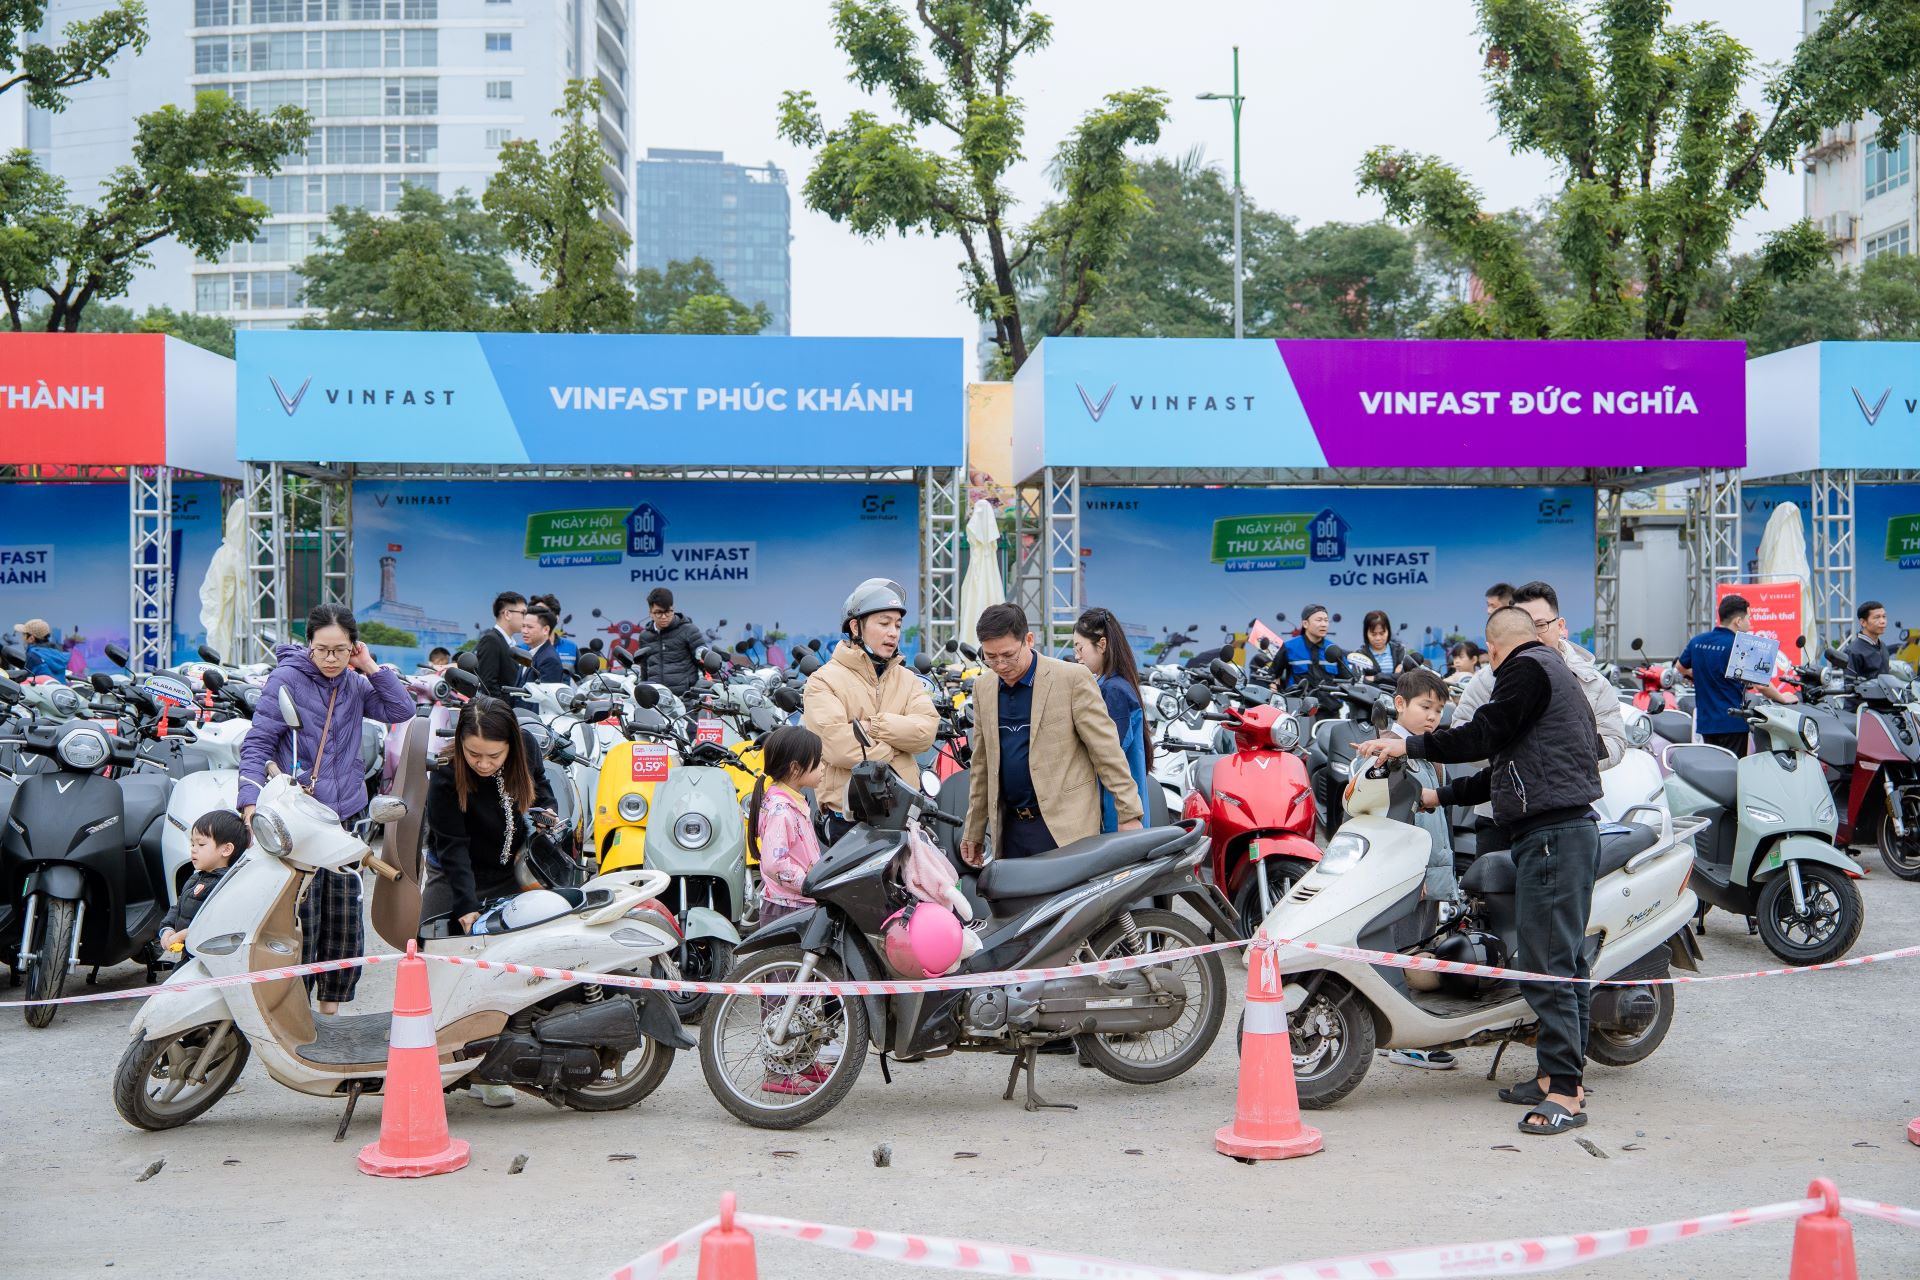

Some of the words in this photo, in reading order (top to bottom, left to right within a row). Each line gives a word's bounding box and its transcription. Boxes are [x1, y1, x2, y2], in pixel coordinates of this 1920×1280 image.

[326, 389, 455, 405] VINFAST
[549, 386, 688, 410] VINFAST
[697, 381, 788, 411] PHÚC
[797, 382, 913, 412] KHÁNH
[1130, 395, 1257, 411] VINFAST
[1359, 391, 1501, 415] VINFAST
[1510, 385, 1582, 415] ĐỨC
[1593, 385, 1699, 415] NGHĨA
[396, 496, 452, 505] VINFAST
[1086, 501, 1139, 510] VINFAST
[551, 515, 586, 529] NGÀY
[590, 514, 613, 529] HỘI
[634, 508, 655, 533] ĐỔI
[1236, 520, 1271, 534] NGÀY
[1274, 520, 1297, 534] HỘI
[1317, 513, 1337, 538] ĐỔI
[541, 535, 574, 548] THU
[577, 531, 622, 546] XĂNG
[634, 535, 656, 553] ĐIỆN
[1227, 540, 1259, 553] THU
[1262, 535, 1306, 551] XĂNG
[672, 548, 750, 562] VINFAST
[1317, 541, 1338, 558] ĐIỆN
[572, 556, 592, 564] NAM
[1256, 561, 1276, 569] NAM
[1354, 552, 1430, 567] VINFAST
[630, 565, 679, 582] PHÚC
[685, 564, 749, 581] KHÁNH
[1329, 570, 1368, 587] ĐỨC
[1373, 569, 1429, 585] NGHĨA
[153, 682, 173, 692] KLARA
[173, 687, 186, 696] NEO
